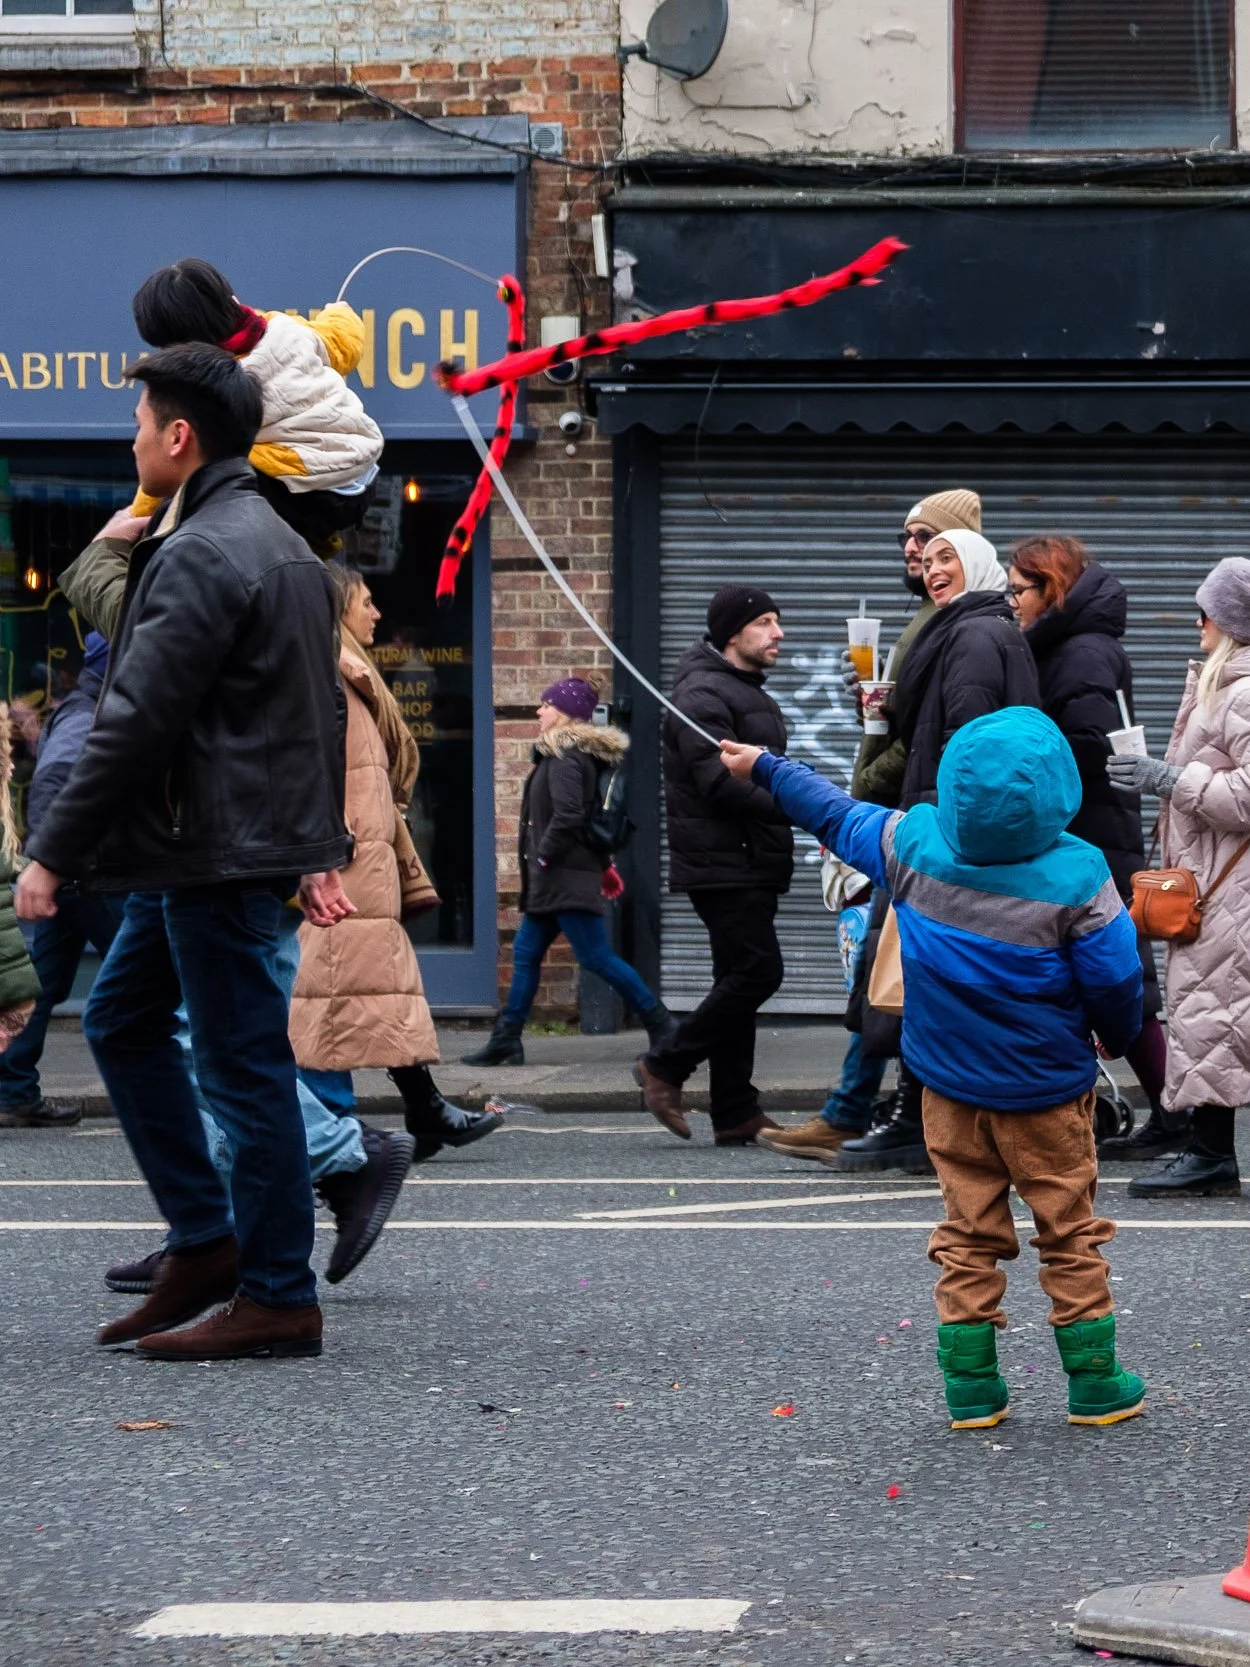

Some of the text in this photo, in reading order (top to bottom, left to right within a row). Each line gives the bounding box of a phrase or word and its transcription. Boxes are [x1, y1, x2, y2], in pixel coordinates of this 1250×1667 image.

[420, 647, 463, 662] WINE
[392, 681, 427, 696] BAR
[400, 702, 432, 717] HOP
[409, 722, 434, 738] OD
